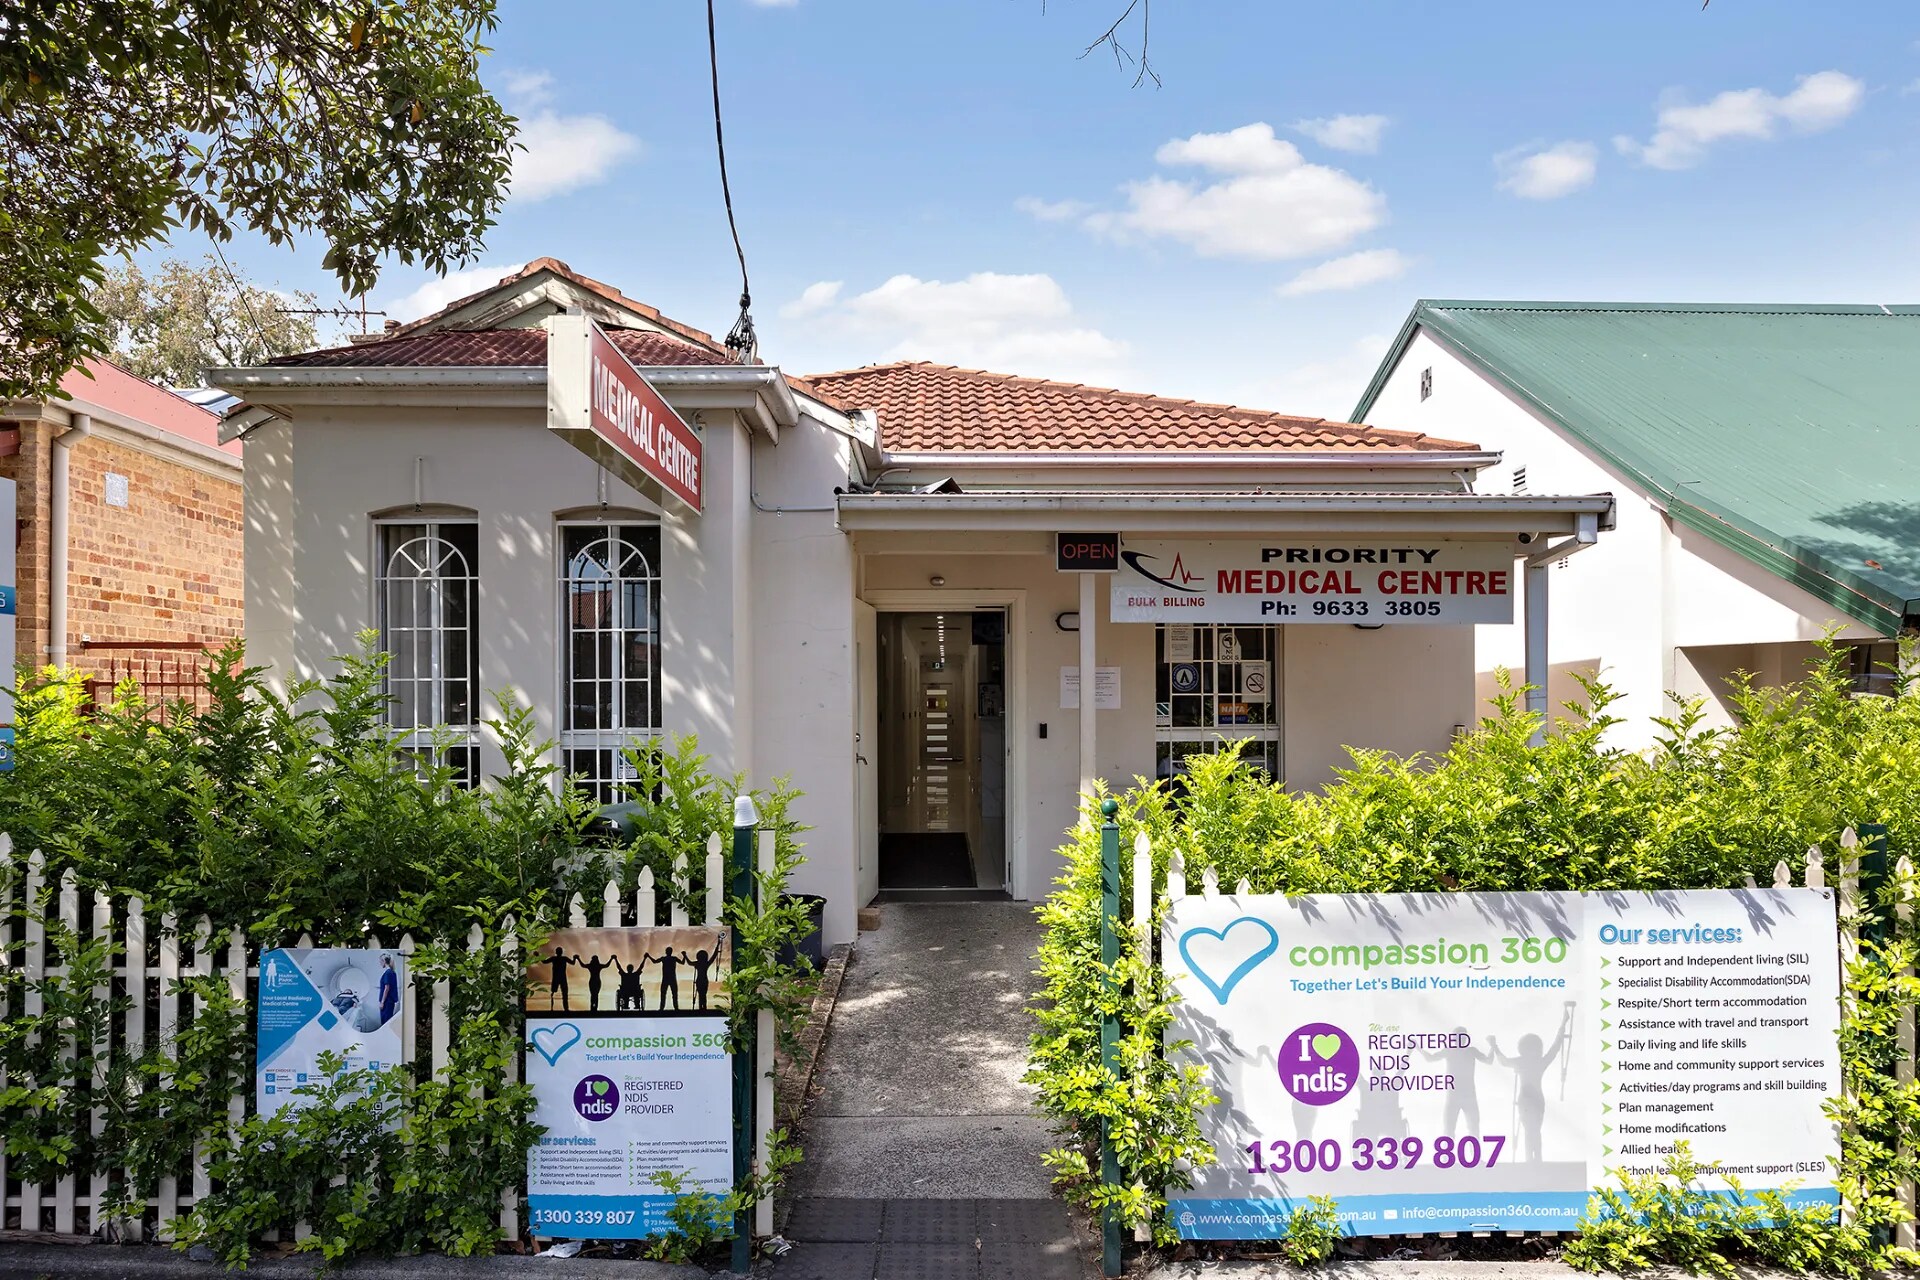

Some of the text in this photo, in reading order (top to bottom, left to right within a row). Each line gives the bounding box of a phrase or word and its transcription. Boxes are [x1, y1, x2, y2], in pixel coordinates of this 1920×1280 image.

[594, 356, 698, 495] MEDICAL CENTRE
[1062, 543, 1115, 559] OPEN
[1261, 548, 1441, 564] PRIORITY
[1217, 570, 1507, 595] MEDICAL CENTRE
[1128, 597, 1205, 608] BULK BILLING
[1261, 601, 1441, 616] Ph: 9633 3805
[1599, 922, 1742, 944] Our services:
[1289, 936, 1567, 971] compassion 360
[1618, 953, 1809, 968] Support and Independent living (SIL)
[1290, 975, 1565, 994] Together Let's Build Your Independence
[1618, 974, 1810, 988] Specialist Disability Accommodation(SDA)
[1618, 996, 1807, 1010] Respite/Short term accommodation
[1619, 1017, 1809, 1029] Assistance with travel and transport
[585, 1033, 724, 1050] compassion 360
[1298, 1034, 1311, 1062] I
[1368, 1033, 1471, 1051] REGISTERED
[1618, 1038, 1747, 1051] Daily living and life skills
[586, 1053, 617, 1062] Together
[674, 1053, 724, 1061] Independence
[1369, 1055, 1410, 1070] NDIS
[1618, 1058, 1824, 1071] Home and community support services
[624, 1080, 684, 1090] REGISTERED
[1293, 1066, 1347, 1094] ndis
[1370, 1075, 1455, 1091] PROVIDER
[1619, 1080, 1827, 1093] Activities/day programs and skill building
[585, 1081, 592, 1096] I
[624, 1093, 648, 1102] NDIS
[581, 1099, 613, 1114] ndis
[624, 1104, 674, 1114] PROVIDER
[1619, 1102, 1714, 1115] Plan management
[1619, 1122, 1726, 1134] Home modifications
[540, 1136, 596, 1146] ur services:
[1245, 1135, 1506, 1174] 1300 339 807
[1621, 1145, 1651, 1155] Allied
[1756, 1163, 1794, 1174] support
[1796, 1162, 1825, 1173] (SLES)
[535, 1209, 572, 1224] 1300
[575, 1210, 604, 1225] 339
[606, 1211, 635, 1225] 807
[1402, 1204, 1579, 1220] info@compassion360.com.au
